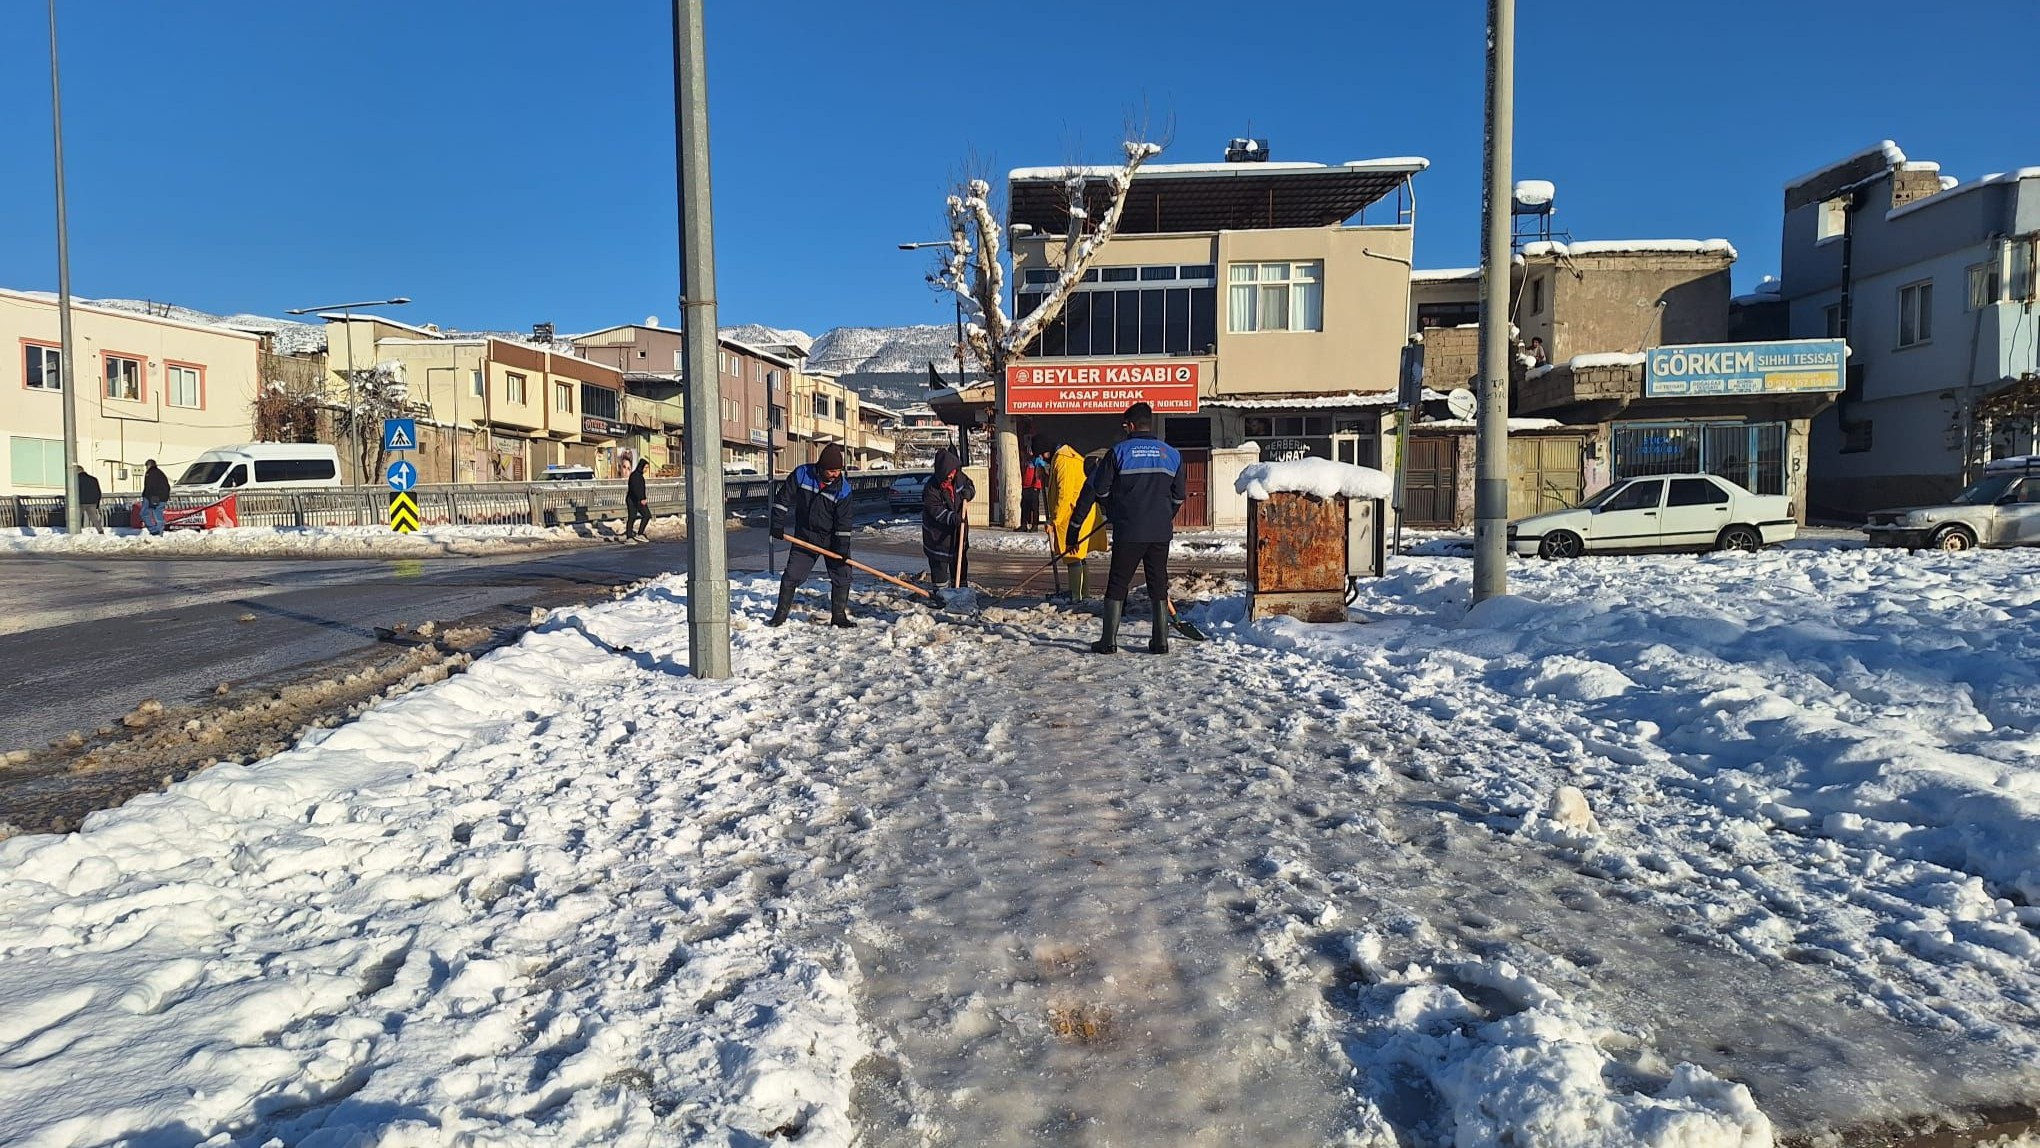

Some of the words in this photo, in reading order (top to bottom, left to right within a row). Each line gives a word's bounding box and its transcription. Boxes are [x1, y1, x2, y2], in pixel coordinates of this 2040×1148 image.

[1652, 350, 1755, 376] GÖRKEM
[1032, 368, 1100, 384] BEYLER
[1106, 367, 1172, 383] KASABI
[1059, 390, 1100, 400] KASAP
[1102, 389, 1143, 399] BURAK
[1012, 401, 1043, 409] TOPTAN
[1083, 400, 1129, 409] PERAKENDE
[1157, 400, 1192, 408] NOKTASI
[1269, 450, 1306, 462] MURAT
